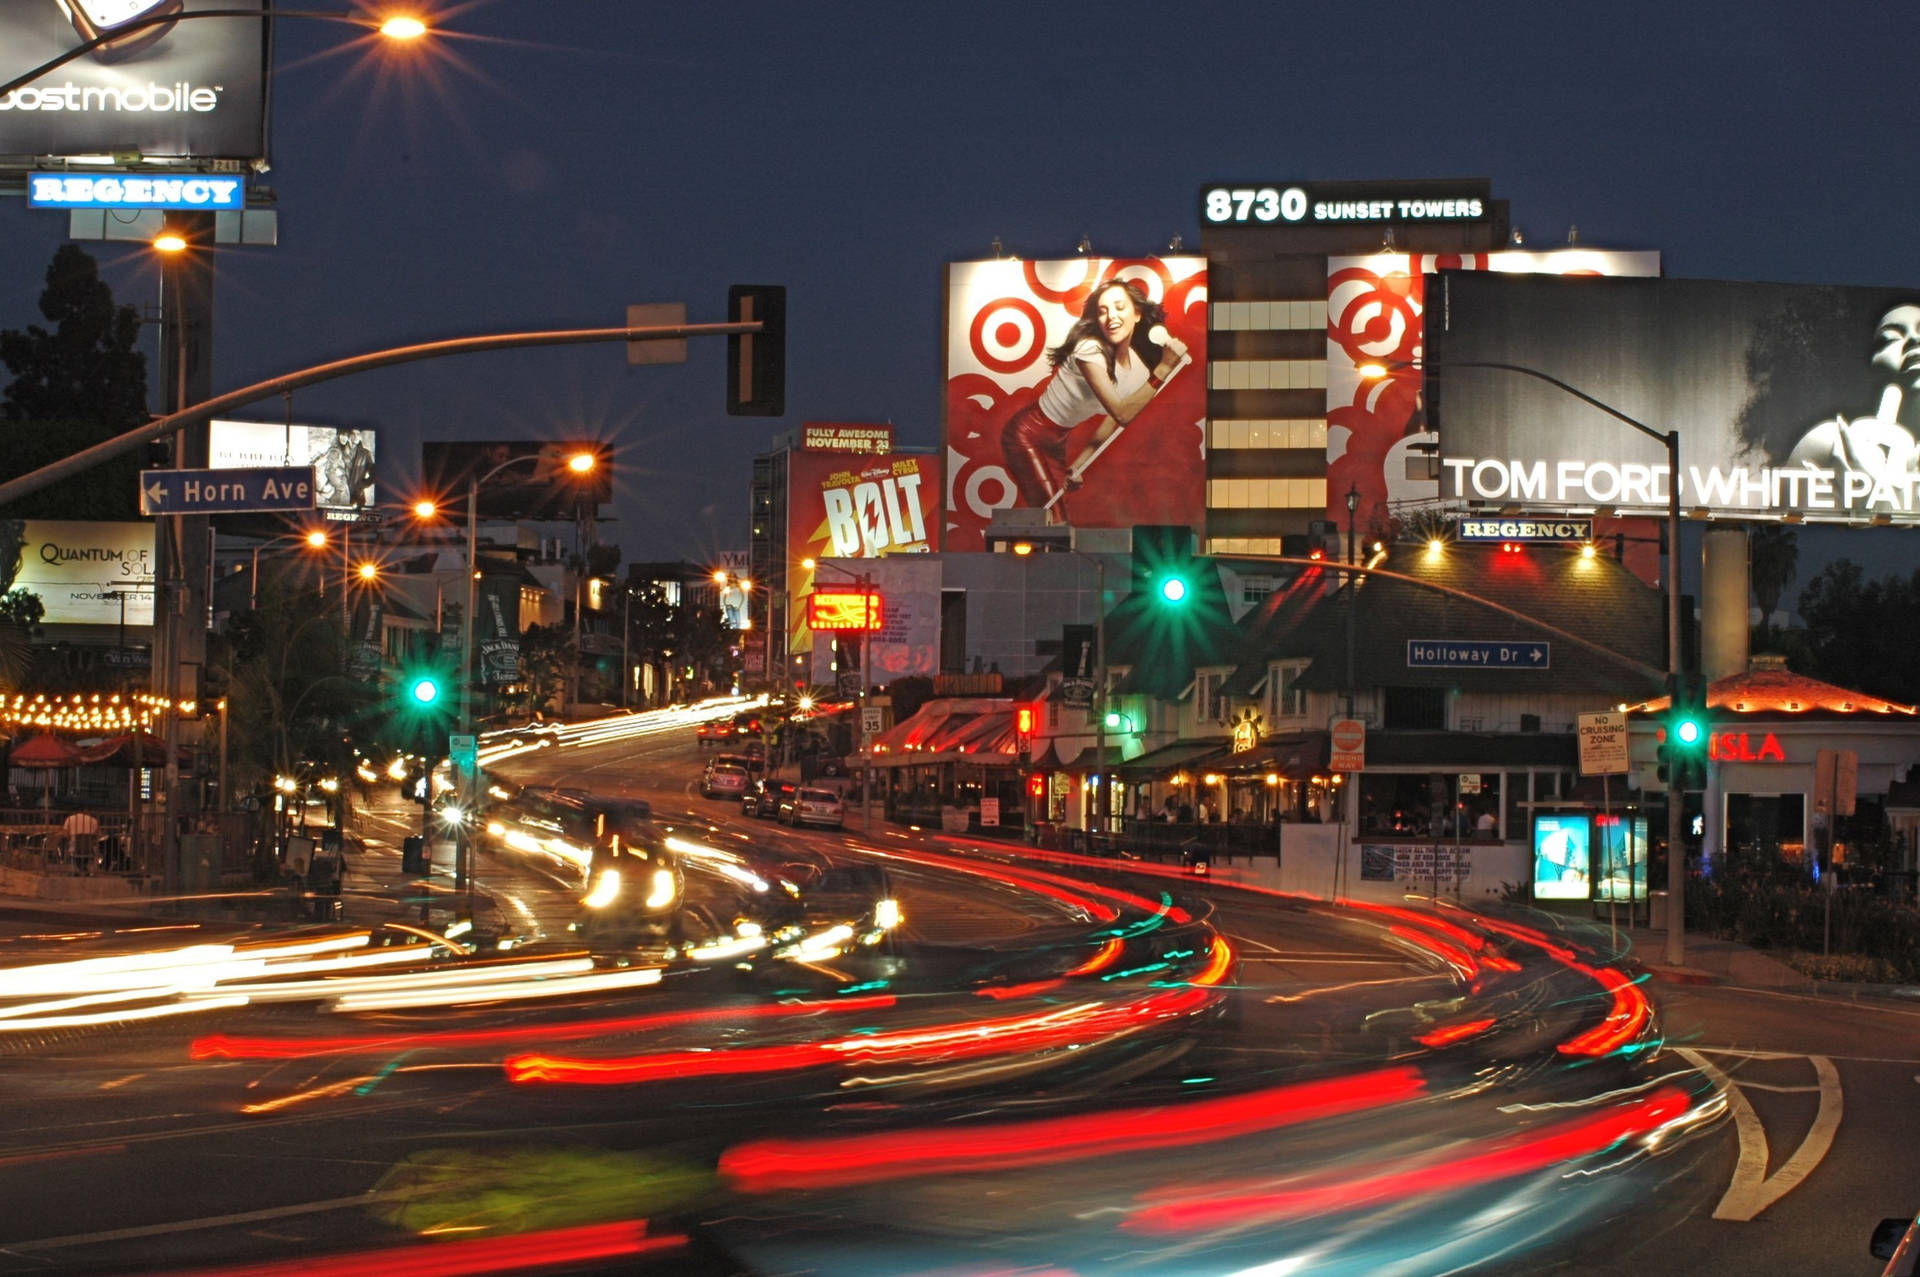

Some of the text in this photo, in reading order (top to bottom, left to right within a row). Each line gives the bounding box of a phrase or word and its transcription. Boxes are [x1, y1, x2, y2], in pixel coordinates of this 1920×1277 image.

[33, 178, 238, 204] REGENCY
[1206, 188, 1483, 222] 8730 SUNSET TOWERS
[806, 428, 889, 439] FULLY AWESOME
[806, 438, 871, 449] NOVEMBER
[829, 471, 851, 481] JOHN
[184, 478, 309, 502] Horn Ave
[1443, 458, 1920, 511] TOM FORD WHITE PAT
[823, 473, 927, 558] BOLT
[1463, 522, 1588, 538] REGENCY
[40, 543, 148, 566] QUANTUM OF
[121, 561, 155, 576] SOL
[1414, 647, 1518, 664] Holloway Dr
[865, 721, 880, 731] 35
[1595, 716, 1609, 724] NO
[1580, 725, 1625, 735] CRUISING
[1590, 735, 1616, 744] ZONE
[1710, 732, 1784, 761] ISLA
